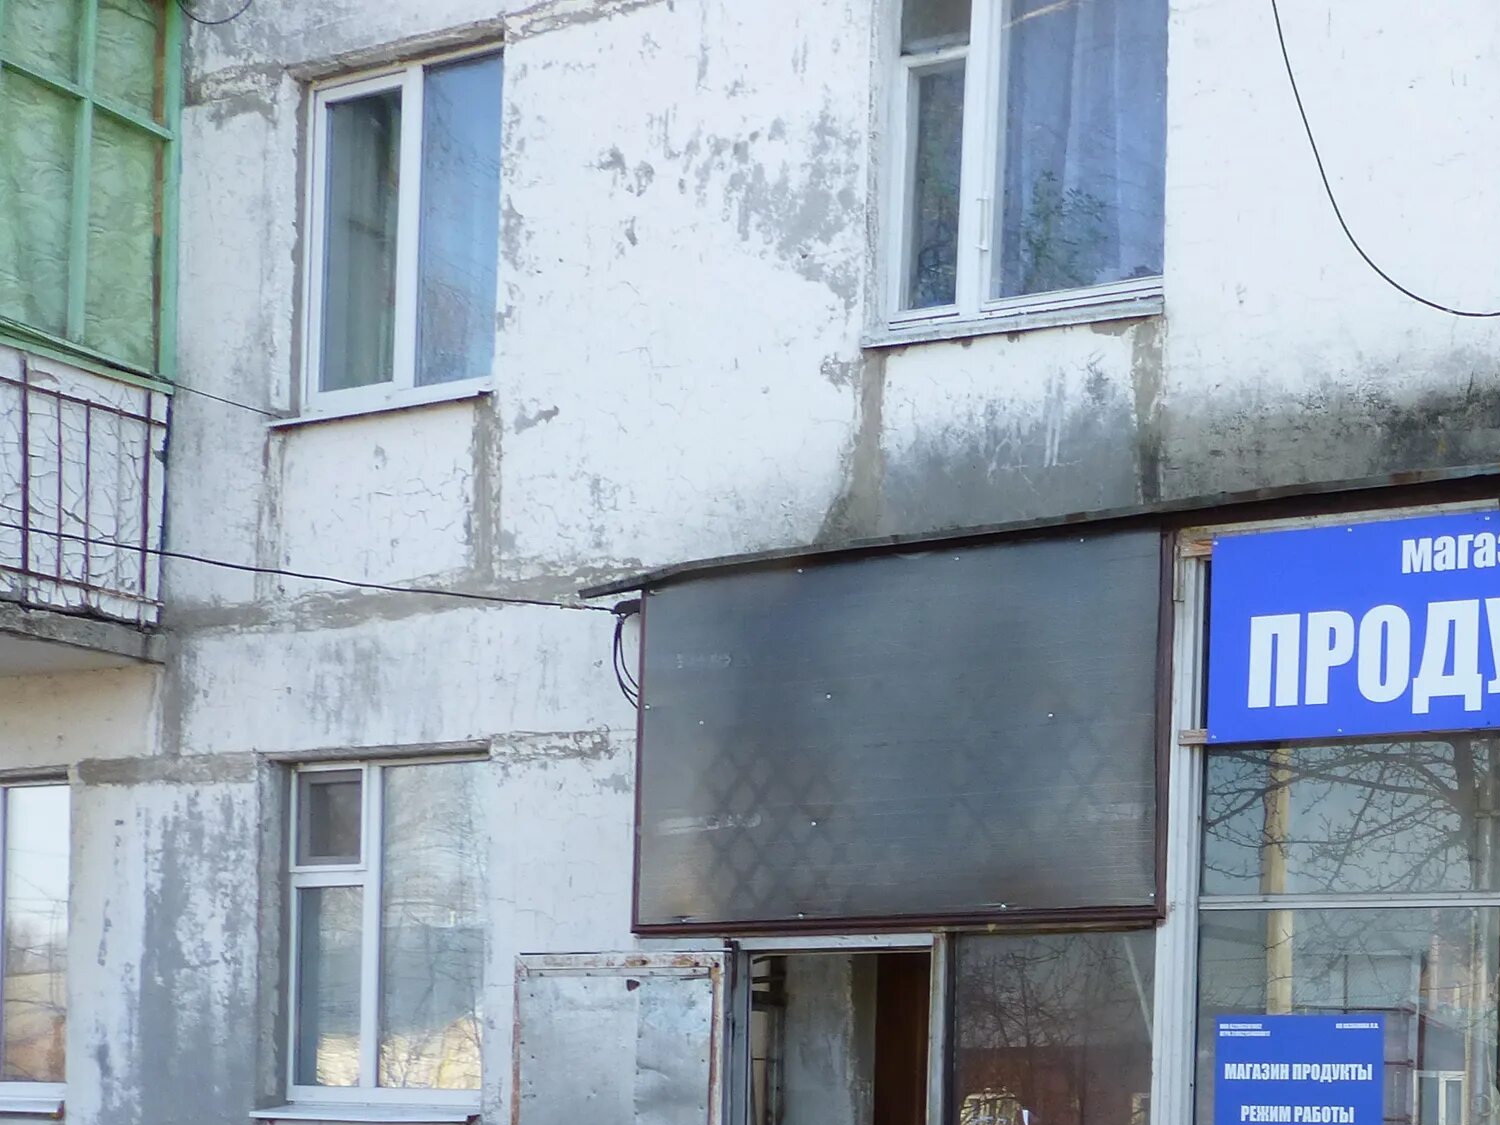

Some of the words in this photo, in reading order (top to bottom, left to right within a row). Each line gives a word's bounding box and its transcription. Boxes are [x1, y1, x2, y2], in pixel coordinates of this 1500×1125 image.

[1224, 1063, 1290, 1080] МАГАЗИН
[1292, 1063, 1373, 1083] ПРОДУКТЫ
[1240, 1105, 1291, 1123] РЕЖИМ
[1294, 1106, 1354, 1124] РАБОТЫ
